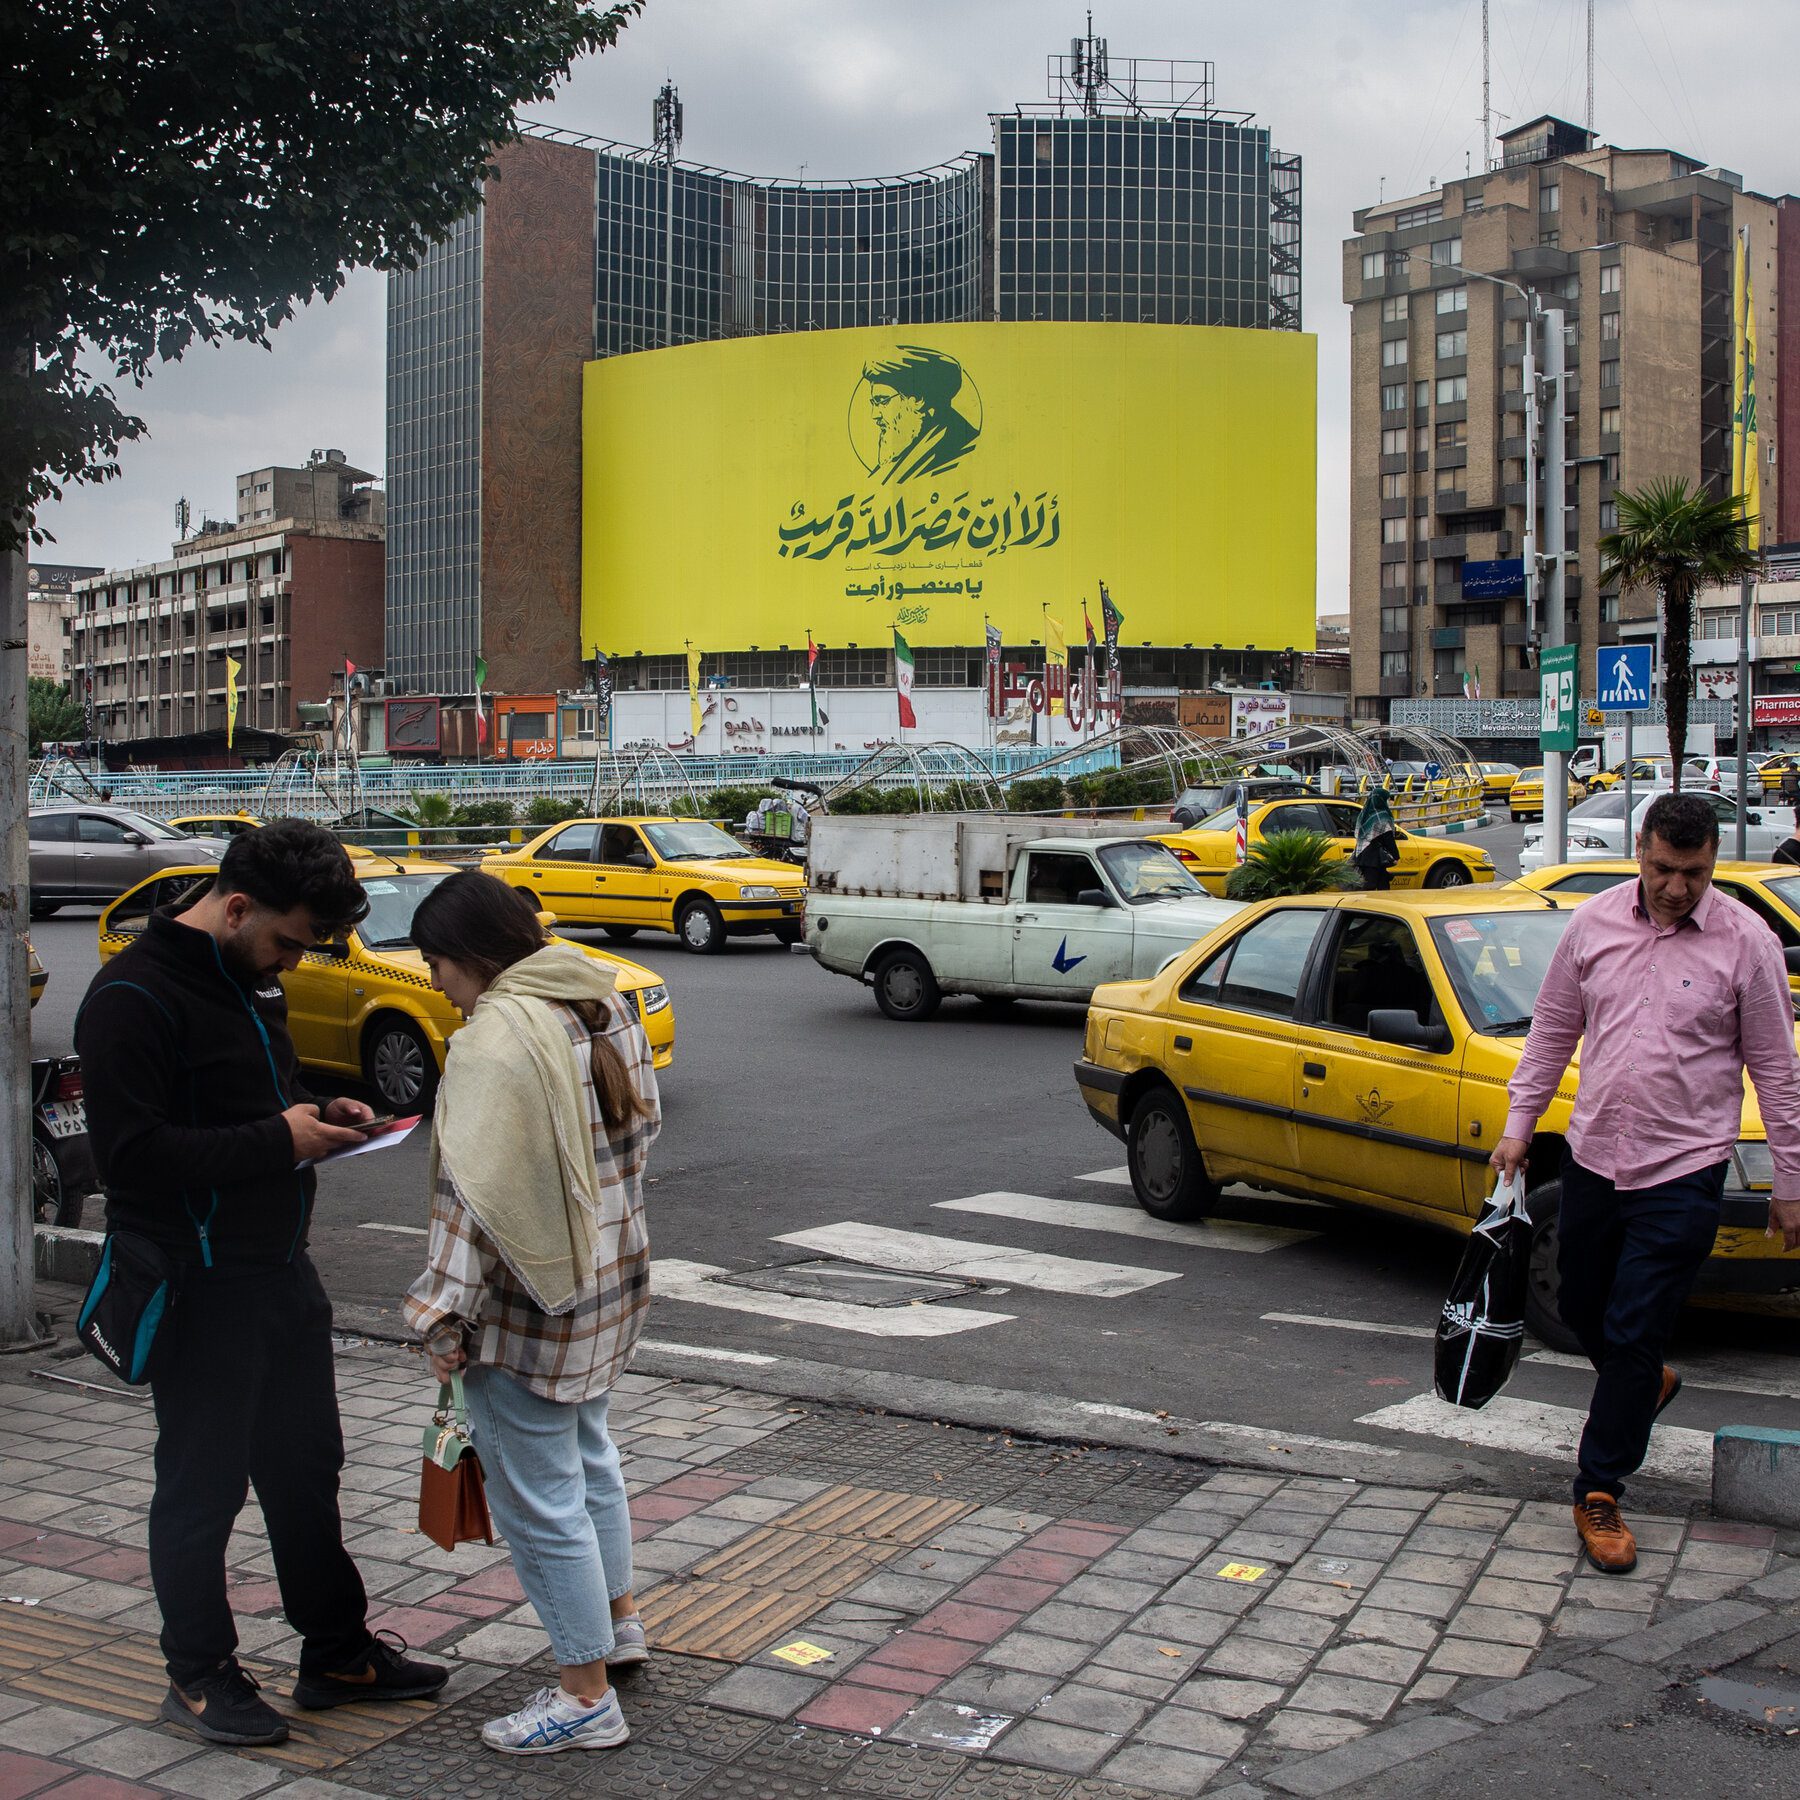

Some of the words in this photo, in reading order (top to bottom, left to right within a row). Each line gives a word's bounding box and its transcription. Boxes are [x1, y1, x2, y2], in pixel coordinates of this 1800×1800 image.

[845, 563, 872, 572] است
[873, 562, 907, 571] نزدیک
[908, 561, 933, 569] خدا
[885, 580, 963, 600] منصور
[965, 578, 983, 599] یا
[1238, 699, 1260, 715] فود
[1261, 697, 1287, 712] فست
[1482, 724, 1516, 733] Meydan-e
[526, 740, 555, 755] دیدار
